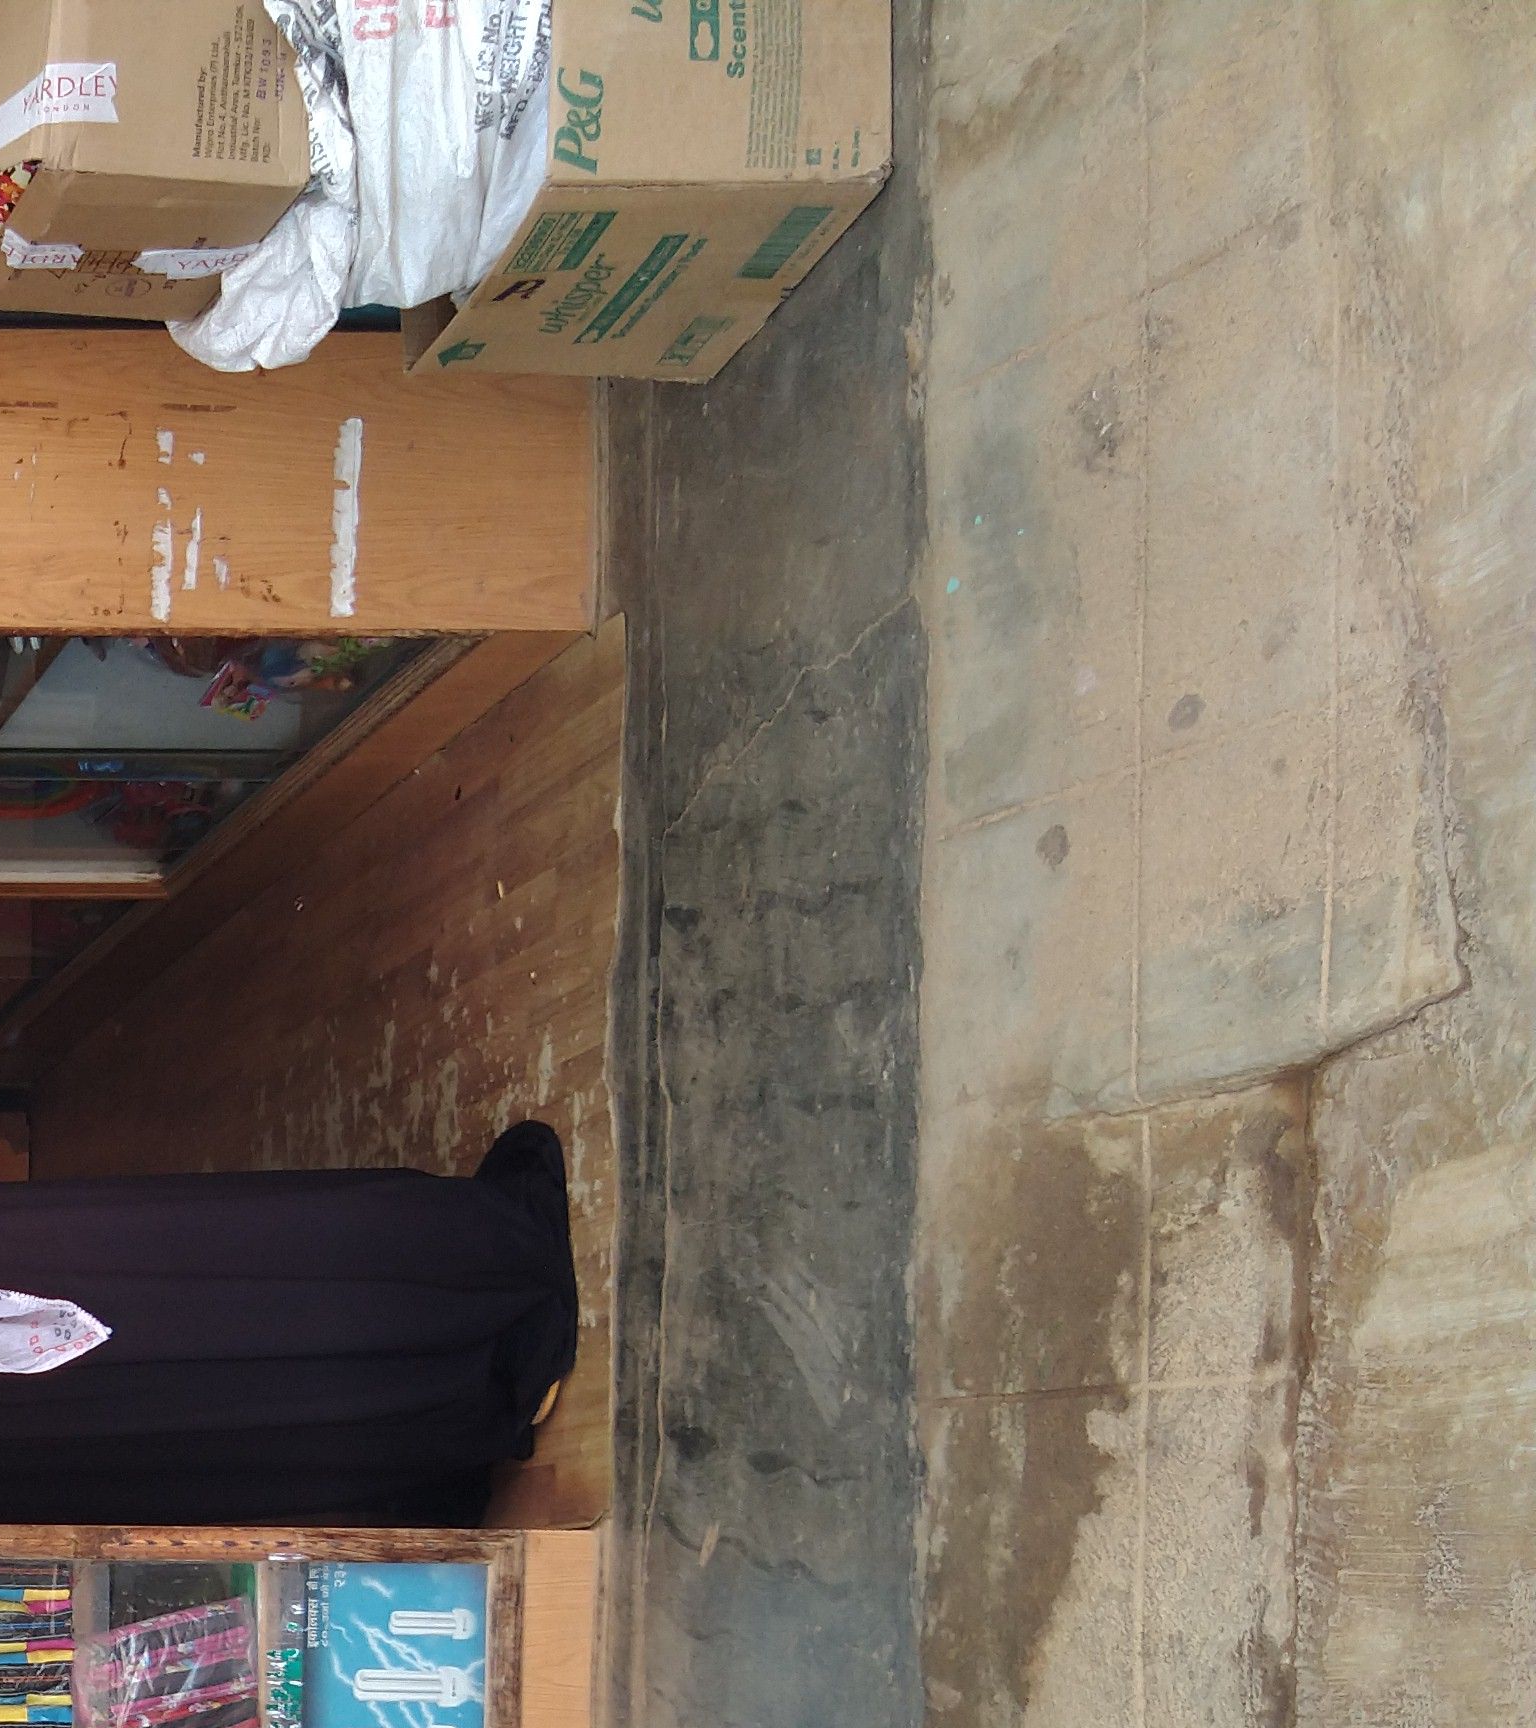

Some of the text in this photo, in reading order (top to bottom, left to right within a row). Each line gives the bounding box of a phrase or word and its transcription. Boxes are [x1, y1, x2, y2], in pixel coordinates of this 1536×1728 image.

[191, 84, 206, 158] Manufactured
[205, 75, 218, 127] Enterprises
[552, 66, 605, 174] P&G
[537, 253, 617, 335] whisper
